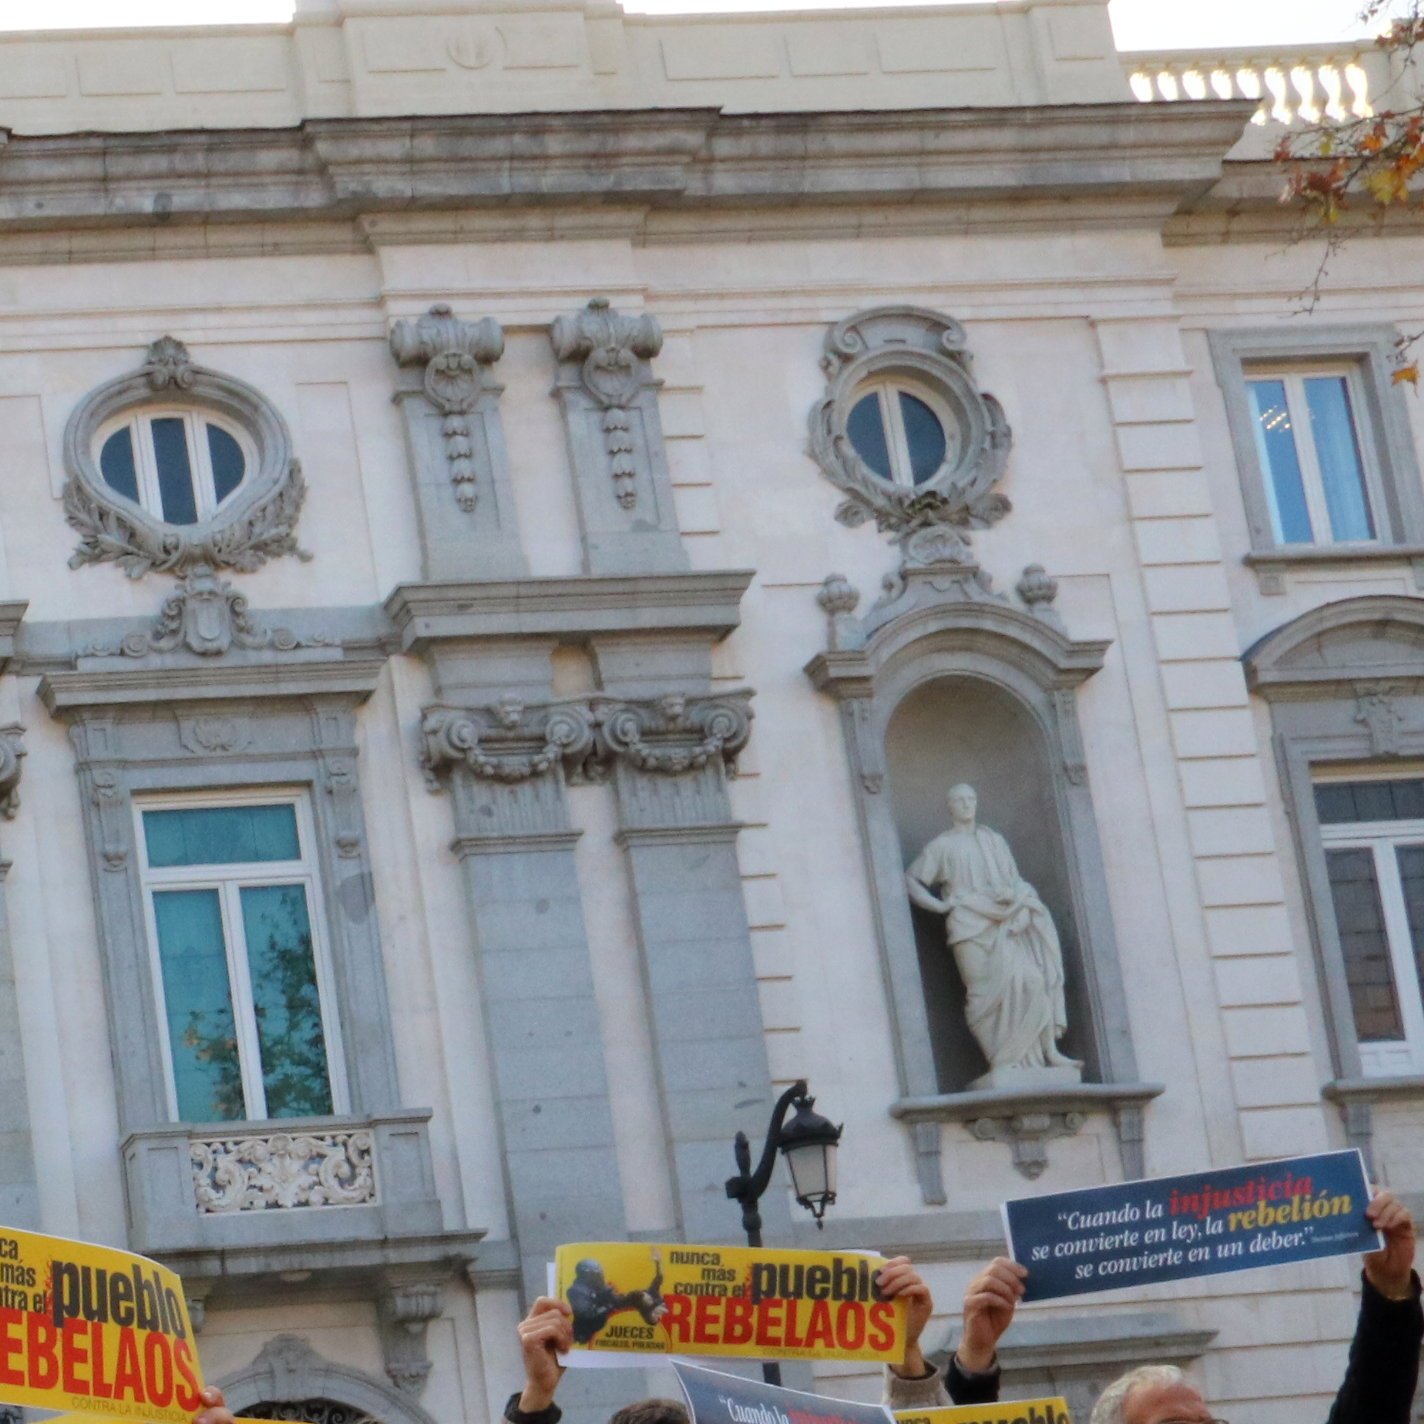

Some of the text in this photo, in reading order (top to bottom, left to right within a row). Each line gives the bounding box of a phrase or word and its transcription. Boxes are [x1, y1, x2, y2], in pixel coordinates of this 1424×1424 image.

[1146, 1200, 1164, 1219] la
[1169, 1172, 1313, 1220] injusticia
[1031, 1189, 1352, 1261] se convierte en ley, la rebelión
[670, 1250, 721, 1266] nunca
[1075, 1264, 1094, 1280] se
[1098, 1248, 1183, 1276] convierte
[1188, 1247, 1210, 1263] en
[1217, 1241, 1243, 1258] un
[33, 1290, 47, 1315] el
[52, 1260, 186, 1340] pueblo
[673, 1281, 746, 1298] contra el
[605, 1325, 655, 1340] JUECES
[663, 1294, 896, 1352] REBELAOS
